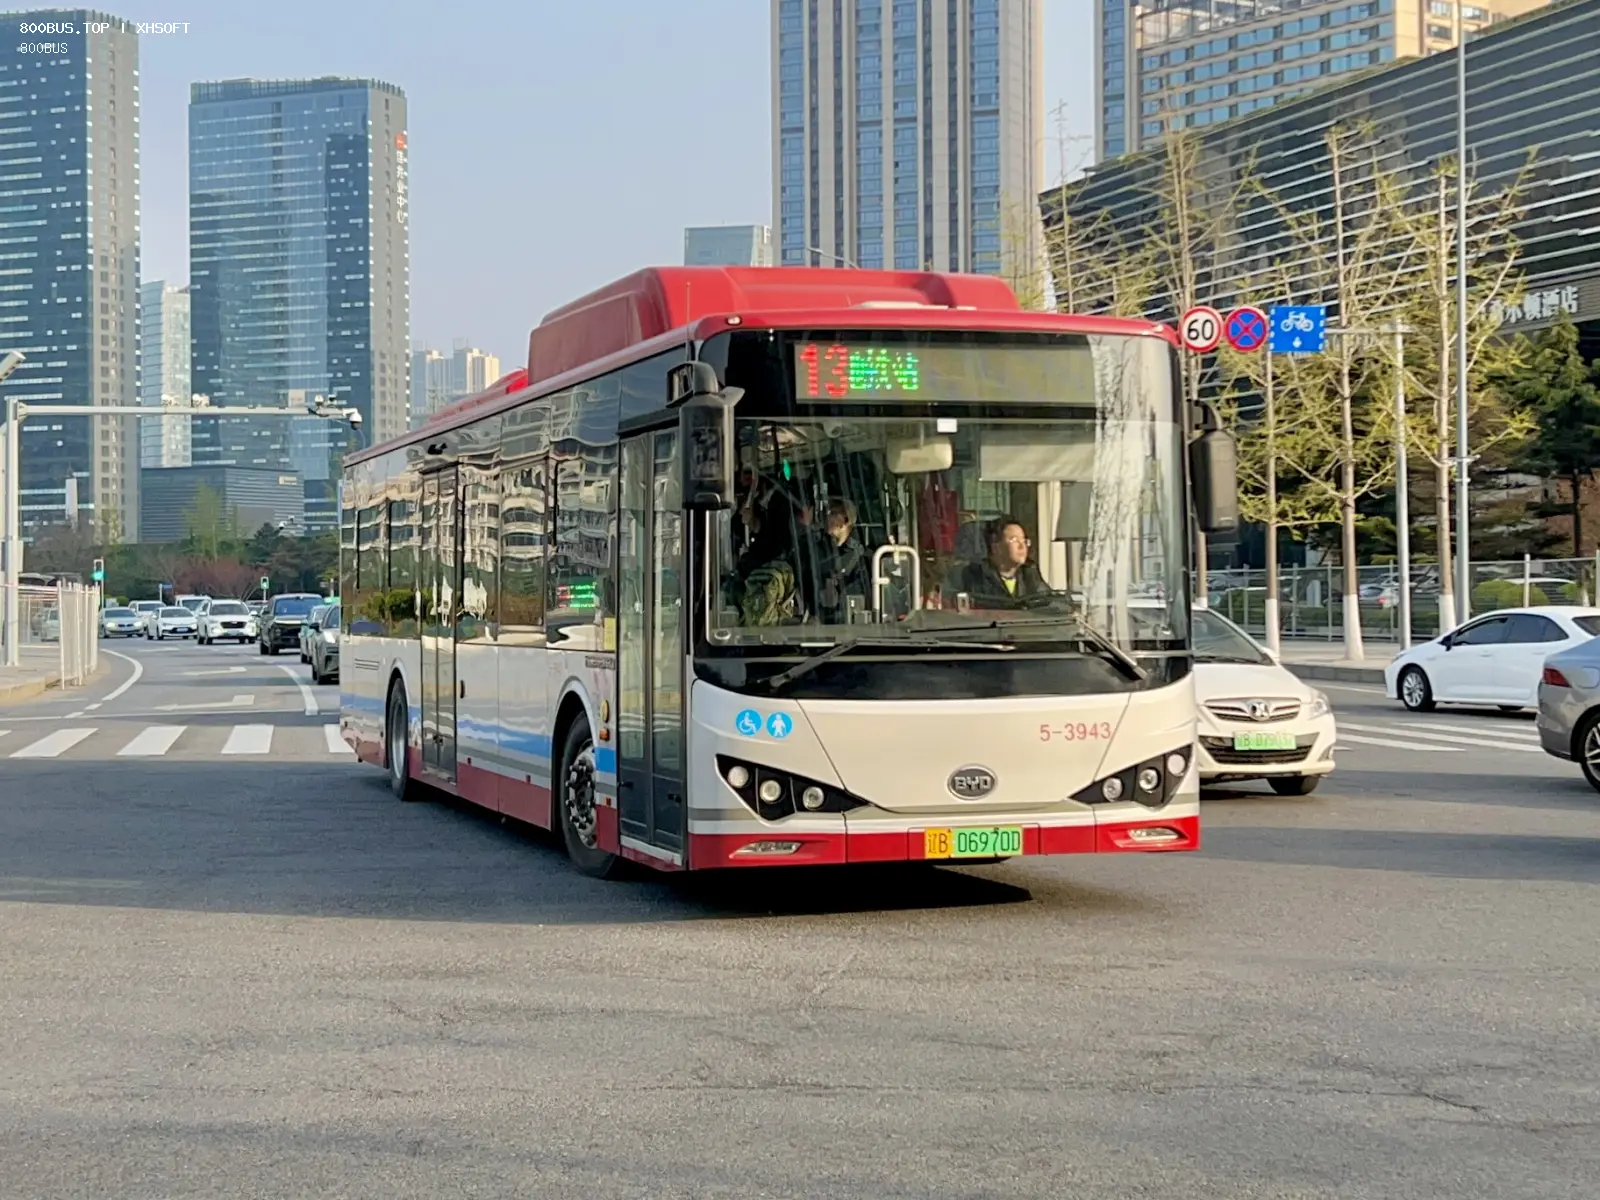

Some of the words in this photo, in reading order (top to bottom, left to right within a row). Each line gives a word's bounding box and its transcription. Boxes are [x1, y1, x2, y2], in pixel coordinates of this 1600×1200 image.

[1187, 318, 1215, 341] 60
[799, 344, 848, 397] 13
[1039, 721, 1112, 742] 5-3943
[954, 775, 993, 791] BYD
